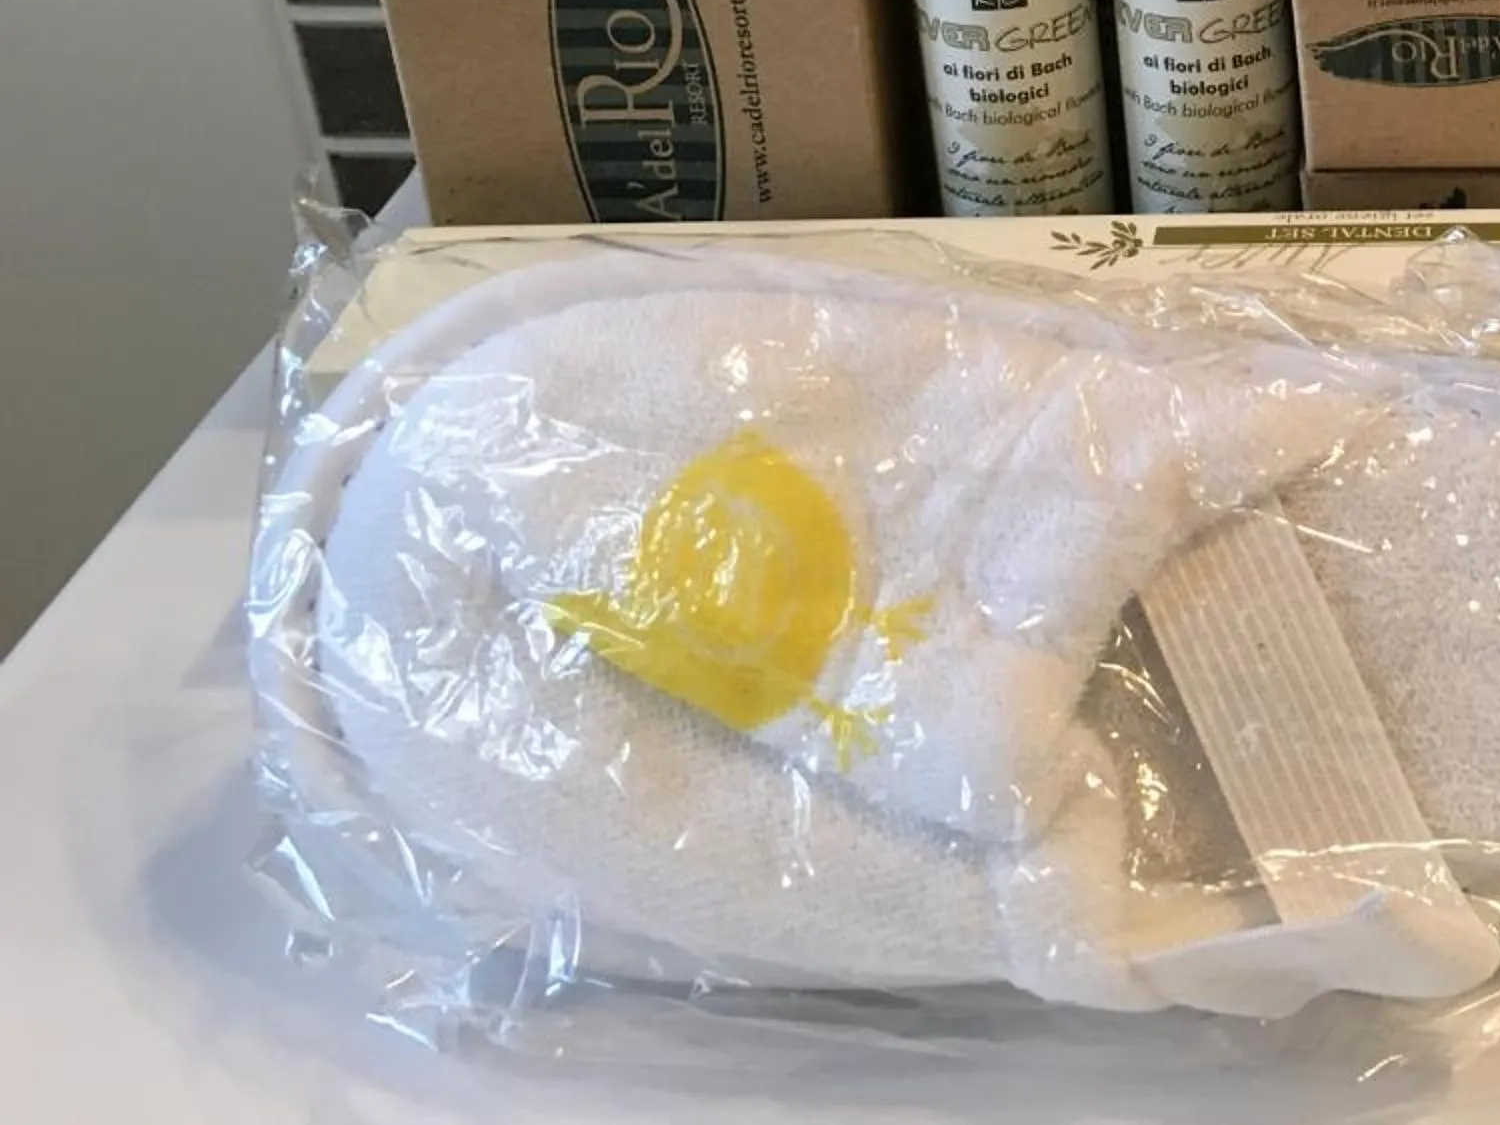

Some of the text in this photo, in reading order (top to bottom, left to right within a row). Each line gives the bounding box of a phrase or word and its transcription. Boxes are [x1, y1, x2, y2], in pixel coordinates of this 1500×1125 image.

[919, 8, 991, 51] VER
[943, 53, 1073, 81] ai fiori di Bach
[1142, 45, 1271, 73] ai fiori di Bach
[684, 60, 708, 125] RESORT
[969, 83, 1050, 104] biologici
[1169, 75, 1249, 96] biologici
[983, 102, 1061, 127] biological
[1182, 92, 1260, 119] biological
[1264, 225, 1432, 240] DENTAL SET
